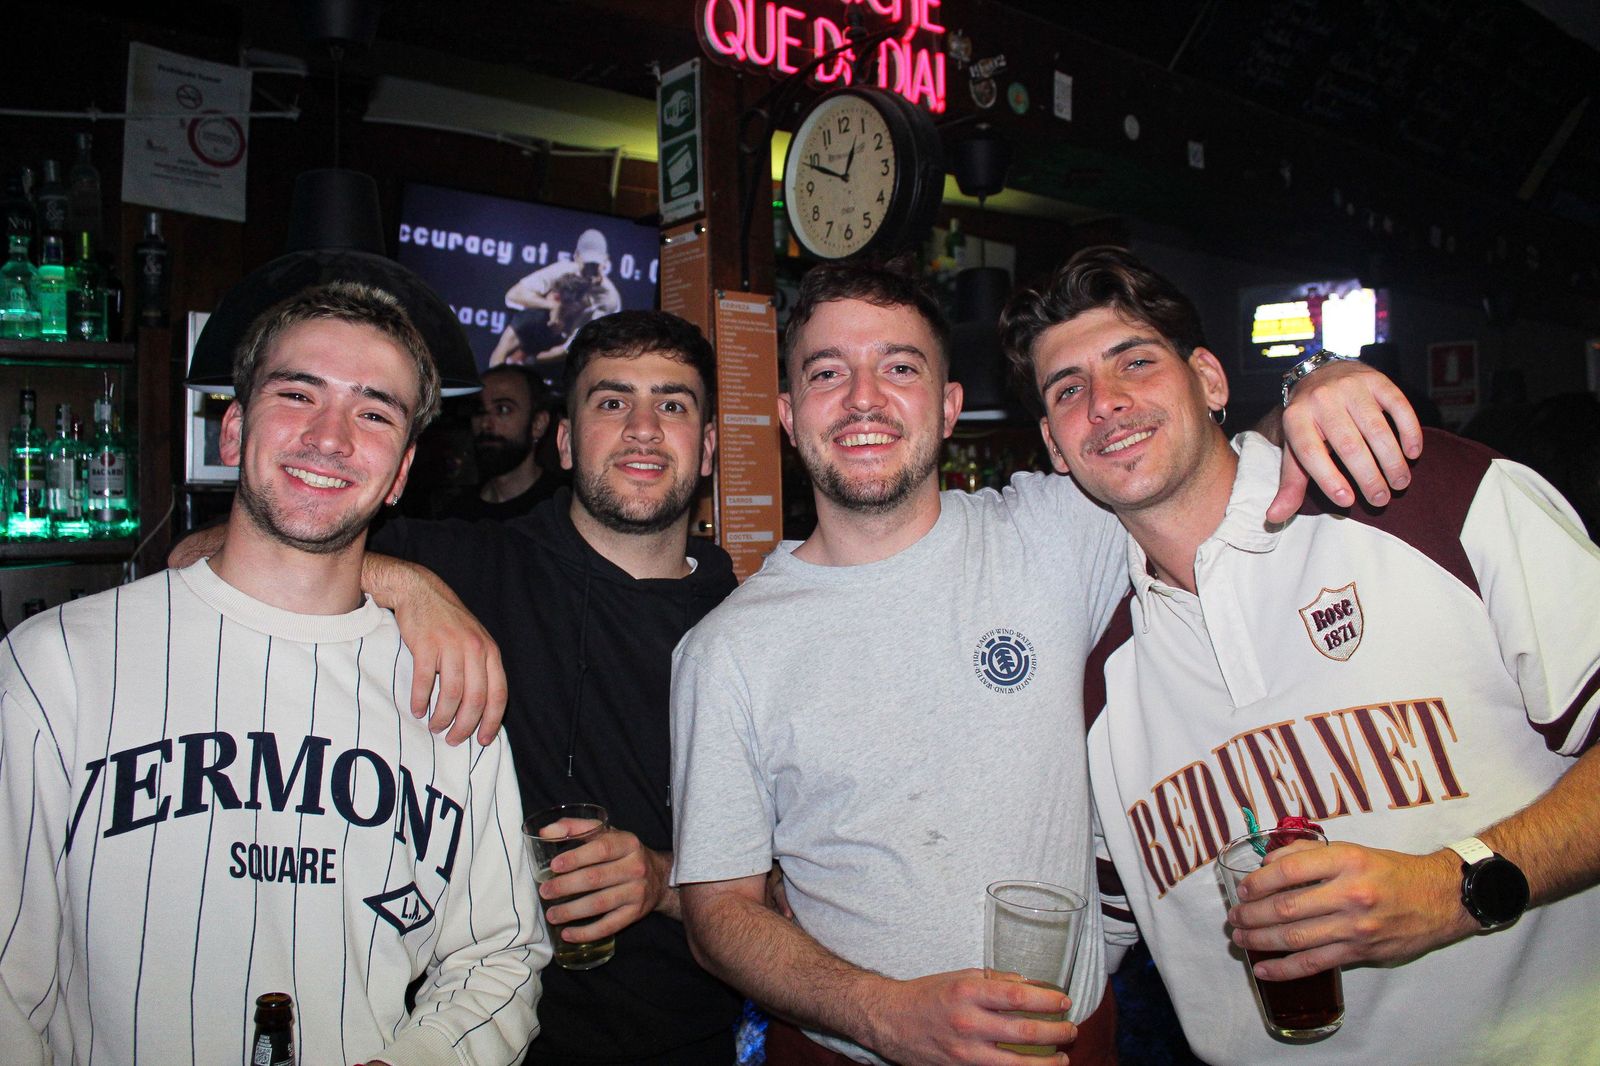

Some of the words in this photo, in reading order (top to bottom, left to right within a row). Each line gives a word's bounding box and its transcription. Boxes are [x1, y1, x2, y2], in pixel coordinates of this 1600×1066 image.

[704, 0, 806, 75] QUE
[837, 116, 850, 134] 12
[861, 117, 866, 134] 1
[822, 129, 832, 147] 11
[873, 132, 883, 151] 2
[809, 152, 820, 169] 10
[881, 159, 890, 176] 3
[806, 181, 815, 197] 9
[876, 189, 885, 205] 4
[811, 205, 820, 222] 8
[862, 211, 871, 229] 5
[826, 221, 834, 238] 7
[844, 223, 853, 241] 6
[522, 241, 548, 265] at
[450, 305, 507, 335] acy
[976, 630, 995, 649] EARTH
[995, 628, 1014, 636] WIND
[1323, 621, 1358, 651] 1871
[1016, 631, 1035, 652] WATER
[974, 668, 993, 691] WATER
[1016, 672, 1035, 691] EARTH
[994, 686, 1015, 694] WIND
[1127, 760, 1232, 900] RED
[1211, 697, 1470, 826] VELVET
[229, 841, 337, 885] SQUARE
